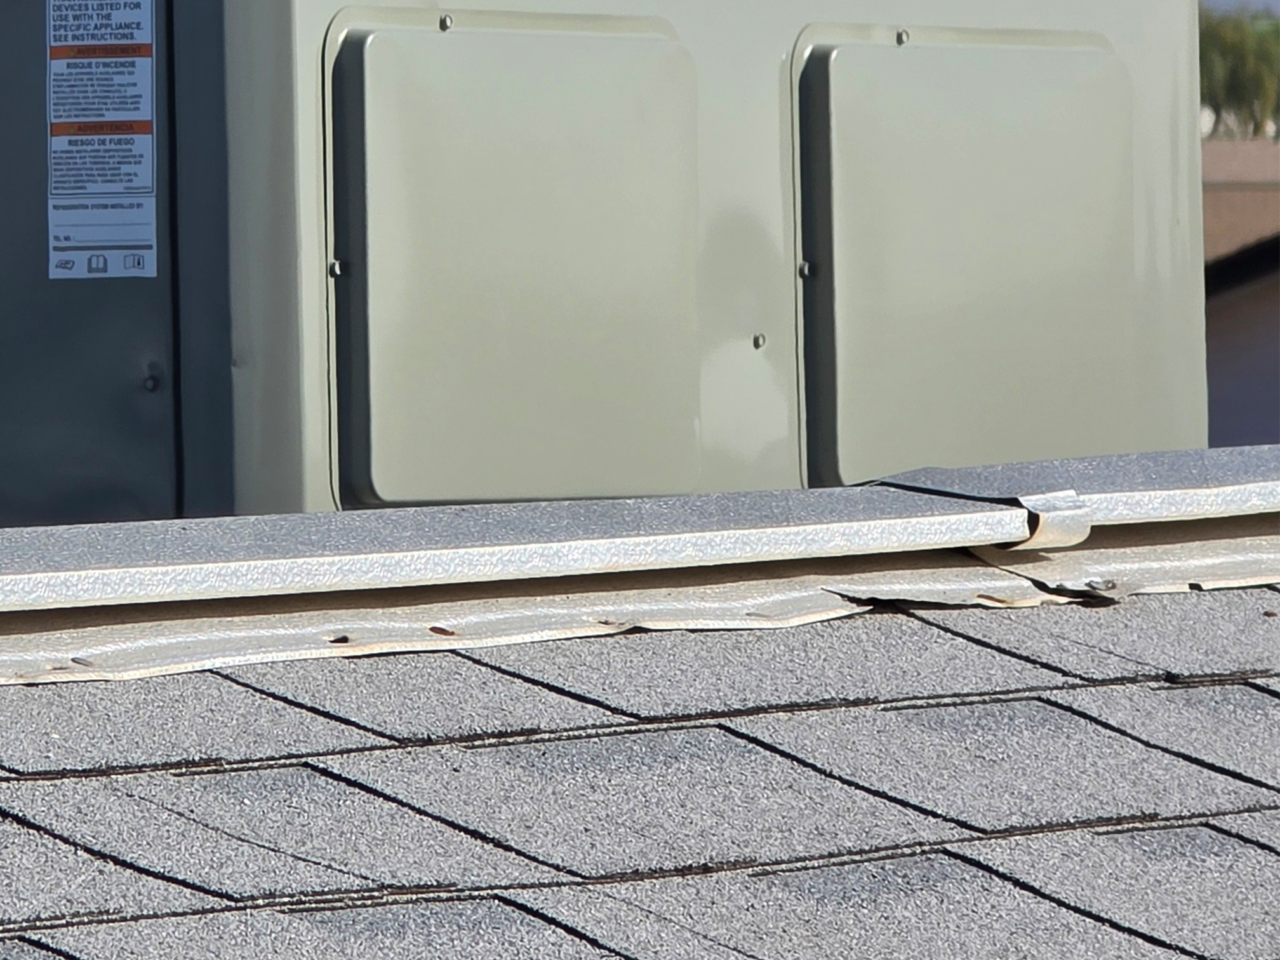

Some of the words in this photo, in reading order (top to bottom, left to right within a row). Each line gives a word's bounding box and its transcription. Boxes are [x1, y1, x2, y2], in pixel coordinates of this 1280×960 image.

[53, 3, 89, 12] DEVICES
[92, 3, 121, 11] LISTED
[124, 2, 141, 10] FOR
[53, 14, 69, 22] USE
[72, 13, 93, 21] WITH
[96, 13, 112, 21] THE
[53, 24, 91, 32] SPECIFIC
[93, 22, 143, 31] APPLIANCE.
[53, 34, 69, 42] SEE
[72, 32, 136, 41] INSTRUCTIONS.
[76, 47, 142, 55] AVERTISSEMENT
[95, 61, 136, 69] D'INCENDIE
[77, 124, 134, 132] ADVERTENCIA
[68, 139, 95, 147] RIESGO
